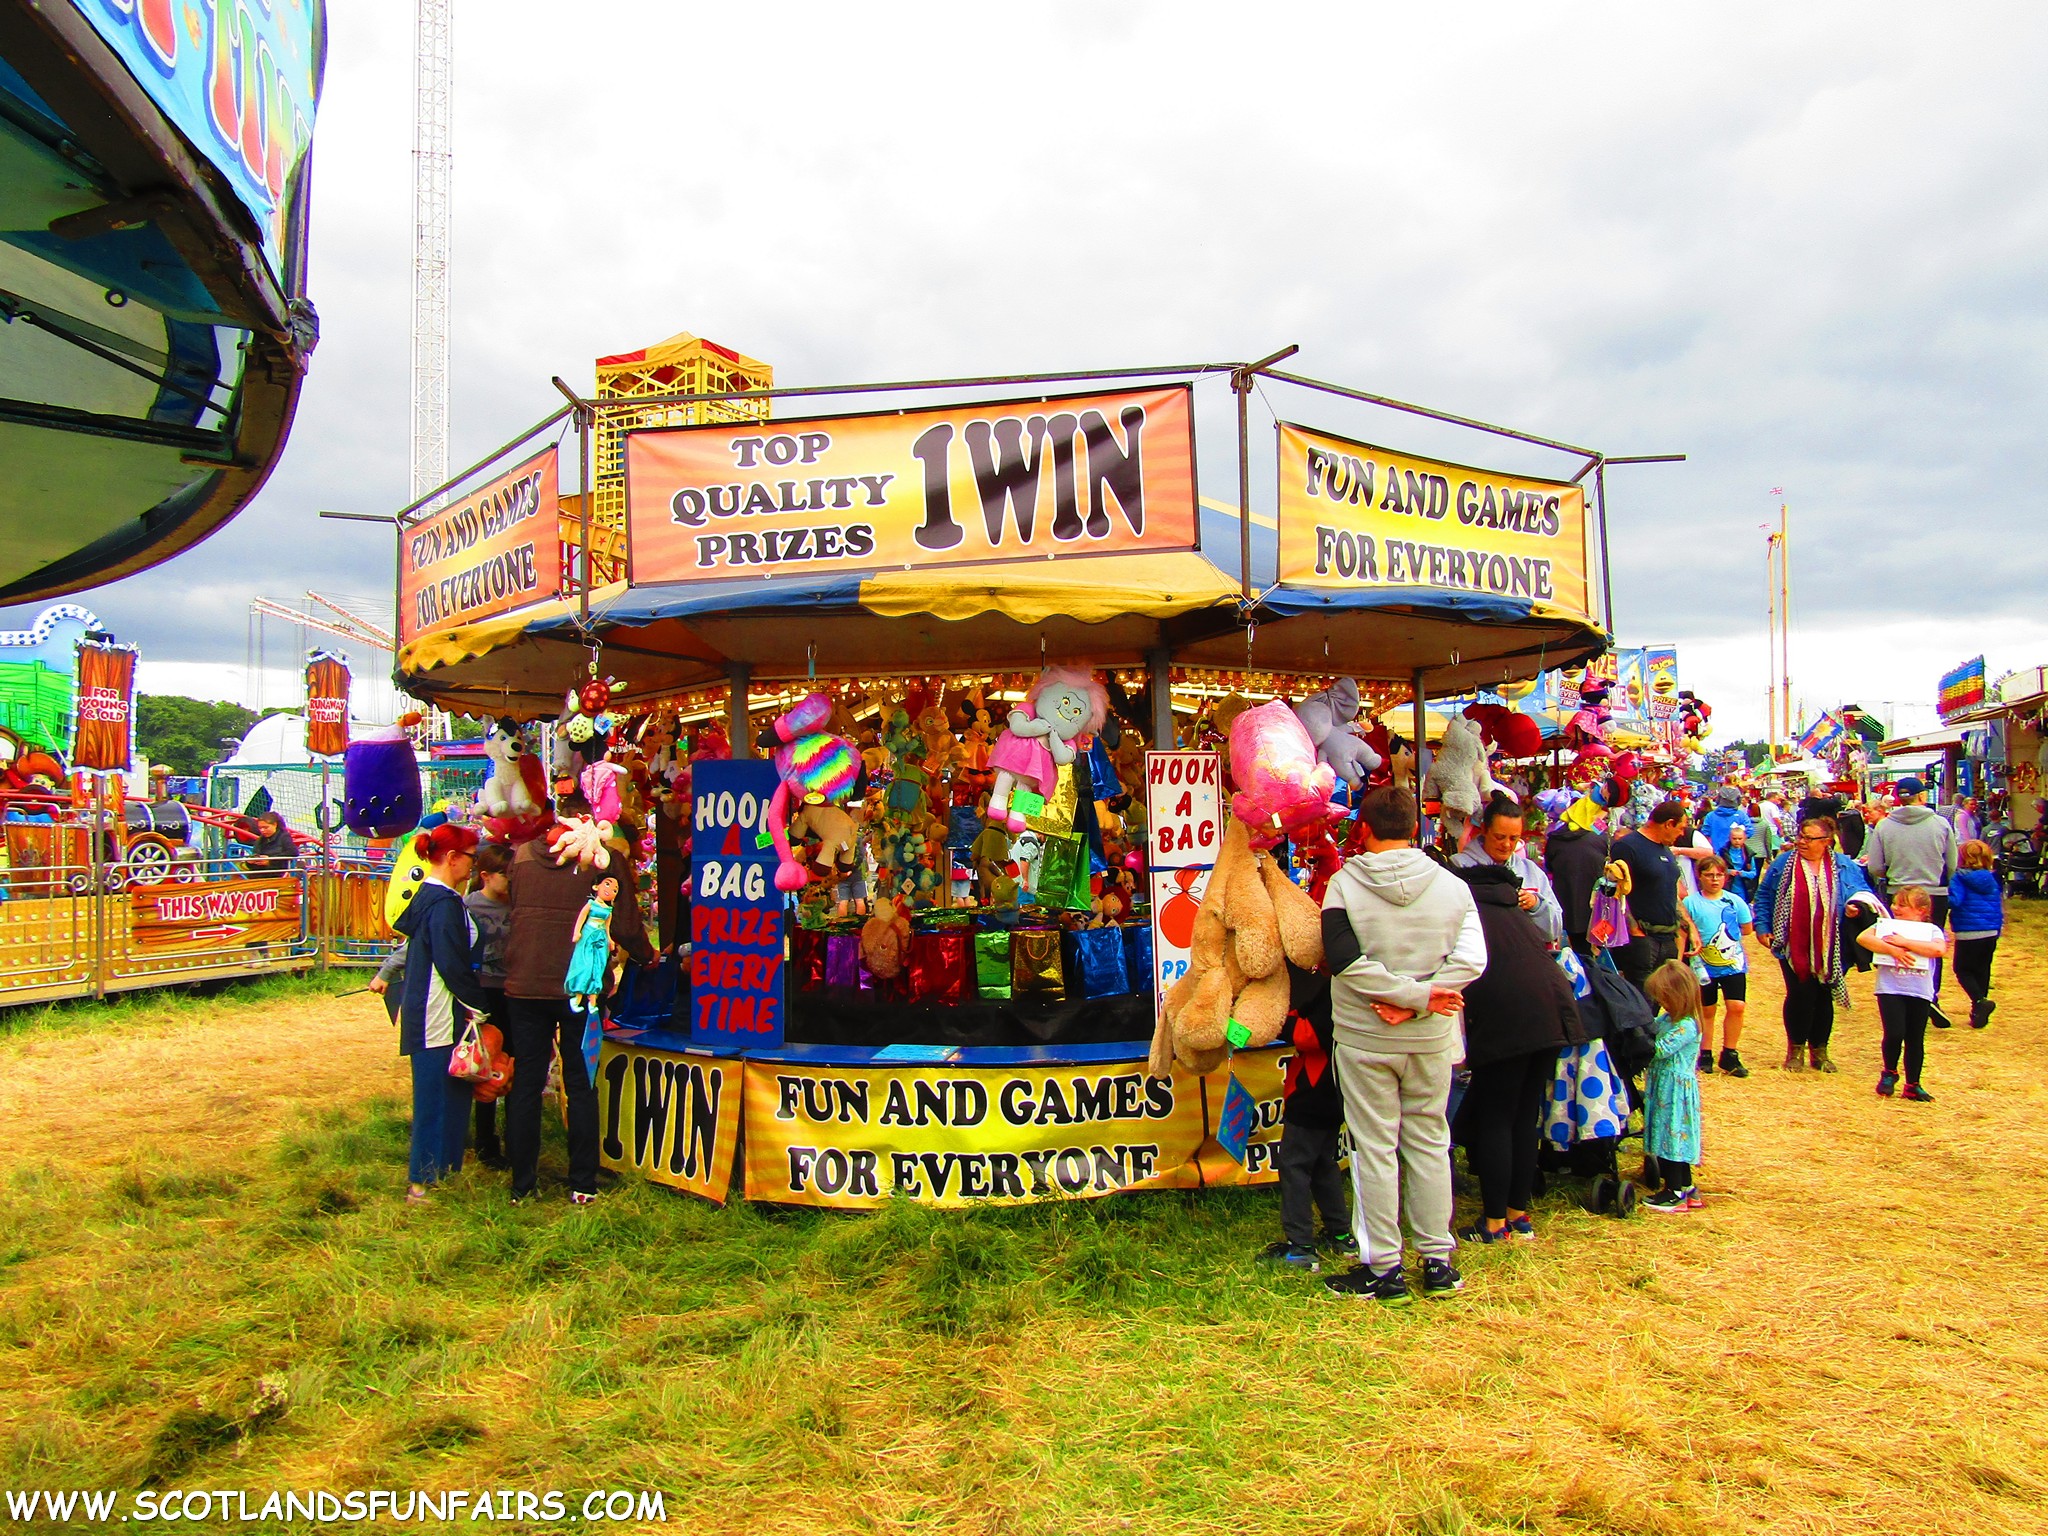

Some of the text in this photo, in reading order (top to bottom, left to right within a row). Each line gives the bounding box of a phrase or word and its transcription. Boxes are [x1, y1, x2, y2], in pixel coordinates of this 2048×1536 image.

[731, 431, 830, 468] TOP
[912, 403, 1146, 550] 1 WIN
[1306, 446, 1560, 537] FUN AND GAMES
[671, 474, 895, 526] QUALITY
[410, 469, 542, 574] FUN AND GAMES
[696, 523, 876, 568] PRIZES
[1314, 526, 1553, 601] FOR EVERYONE
[415, 541, 537, 631] FOR EVERYONE
[1648, 659, 1675, 672] DUCK
[92, 687, 119, 700] FOR
[1560, 680, 1580, 691] PRIZ
[1652, 695, 1678, 706] PRIZE
[81, 697, 128, 712] YOUNG
[84, 709, 125, 722] & OLD
[309, 698, 346, 712] RUNAWAY
[315, 709, 340, 723] TRAIN
[1560, 699, 1576, 708] TIME
[1653, 703, 1676, 713] EVERY
[1653, 711, 1670, 720] TIME
[1150, 758, 1217, 786] HOOK
[1175, 791, 1192, 817] A
[721, 823, 742, 856] A
[1158, 820, 1215, 853] BAG
[700, 861, 766, 901] BAG
[159, 889, 279, 920] THIS WAY OUT
[691, 904, 781, 947] PRIZE
[691, 949, 784, 992] EVERY
[697, 994, 778, 1034] TIME
[775, 1075, 869, 1124] FUN
[880, 1078, 987, 1127] AND
[1000, 1074, 1175, 1127] GAMES
[633, 1055, 723, 1184] WIN
[788, 1144, 1160, 1200] FOR EVERYONE
